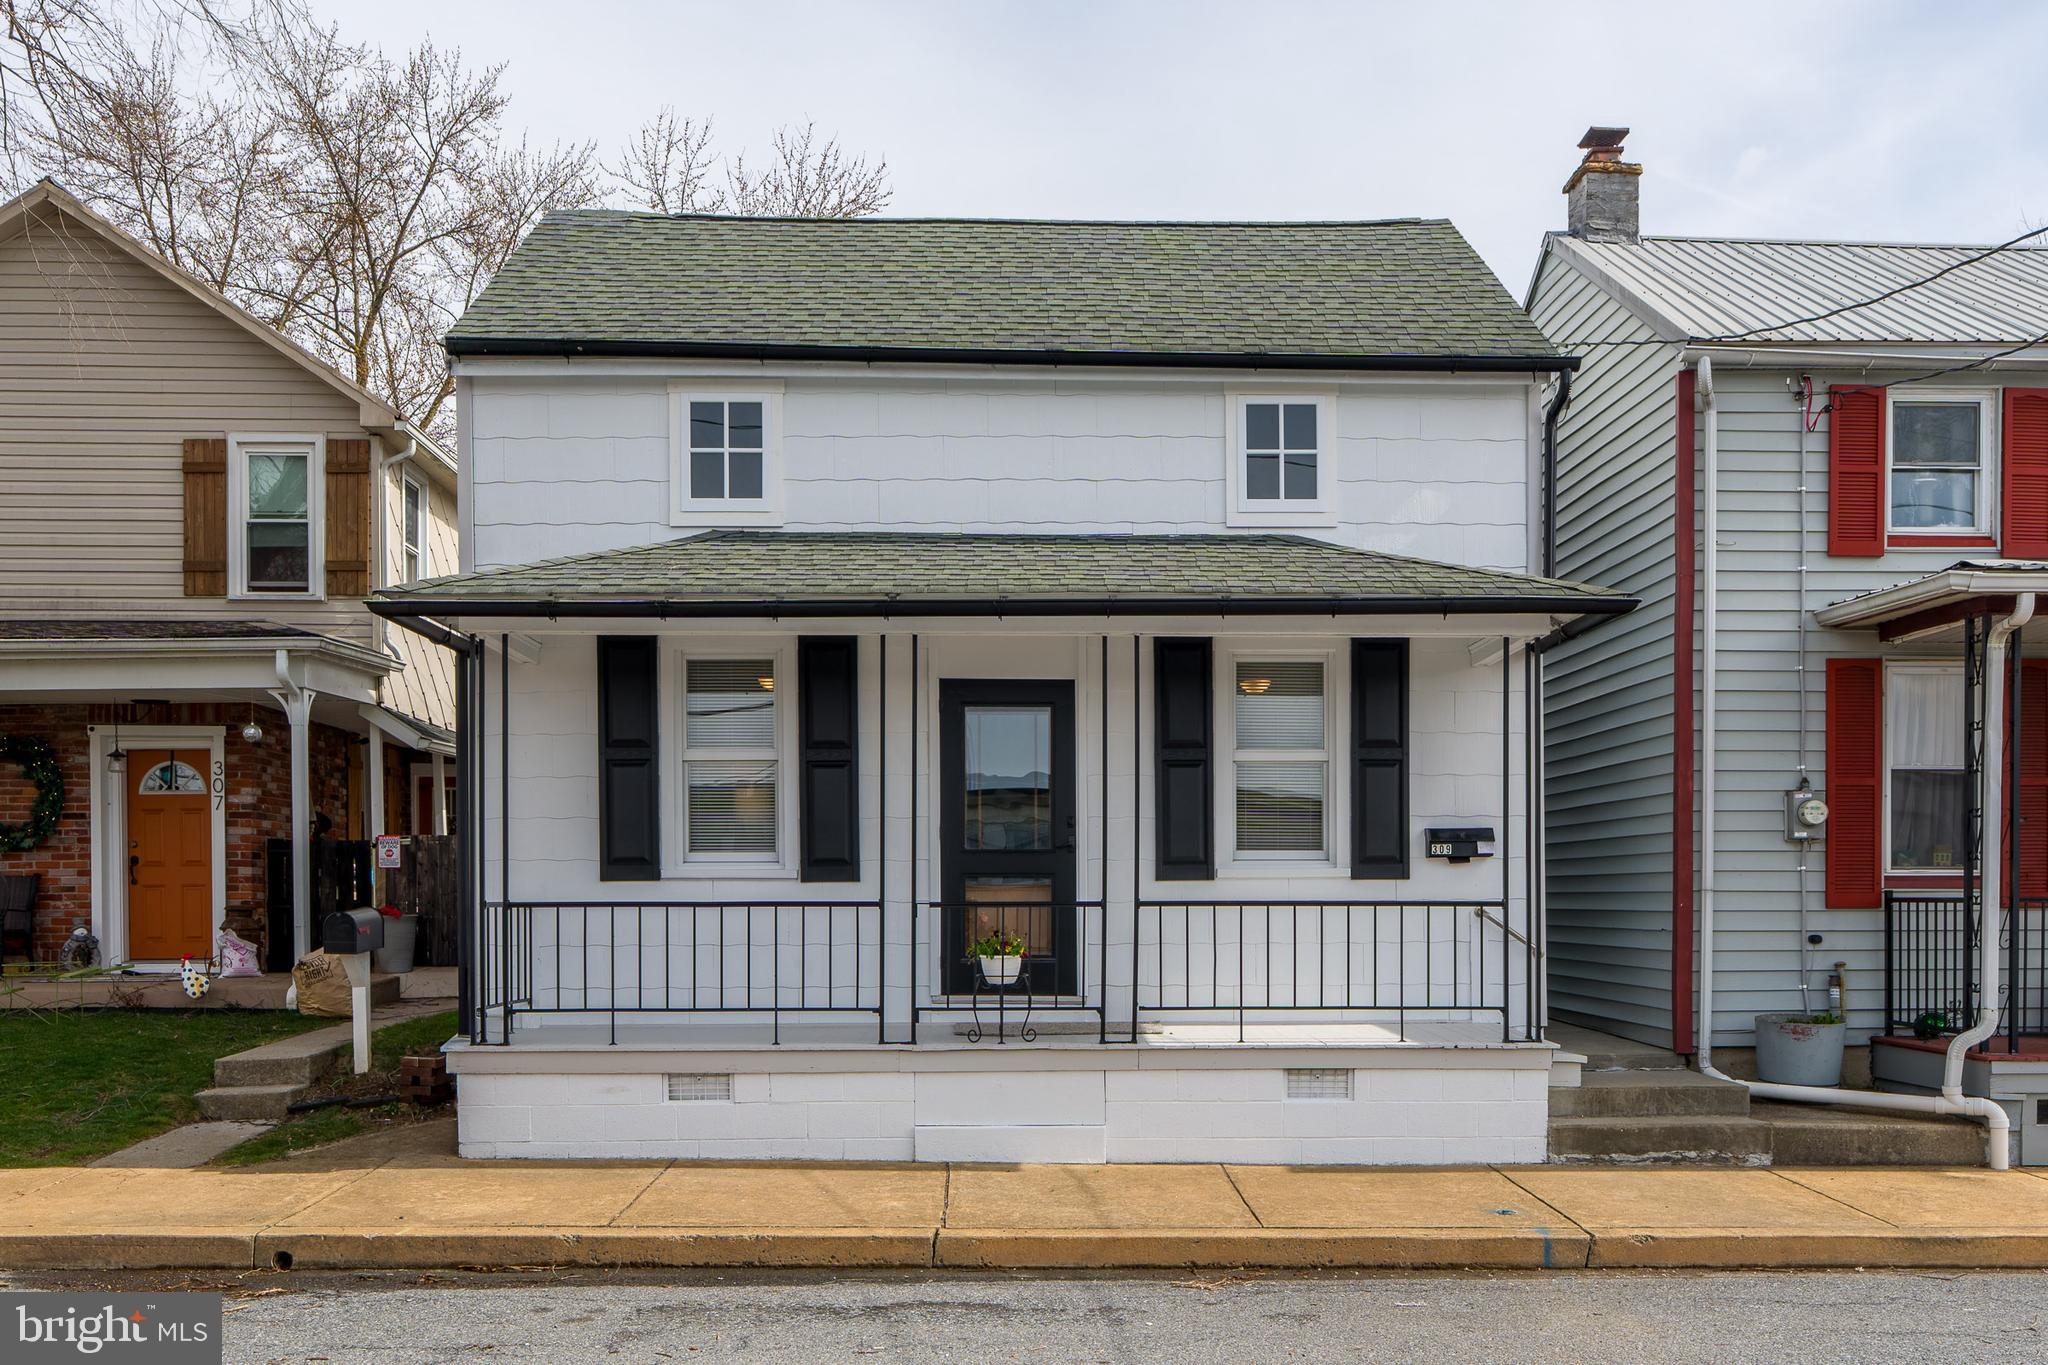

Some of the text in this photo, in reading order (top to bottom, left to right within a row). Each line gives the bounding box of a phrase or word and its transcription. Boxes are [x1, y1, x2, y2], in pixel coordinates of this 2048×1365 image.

[213, 760, 224, 811] 307
[1432, 844, 1451, 854] 309
[304, 966, 326, 980] RIGHT
